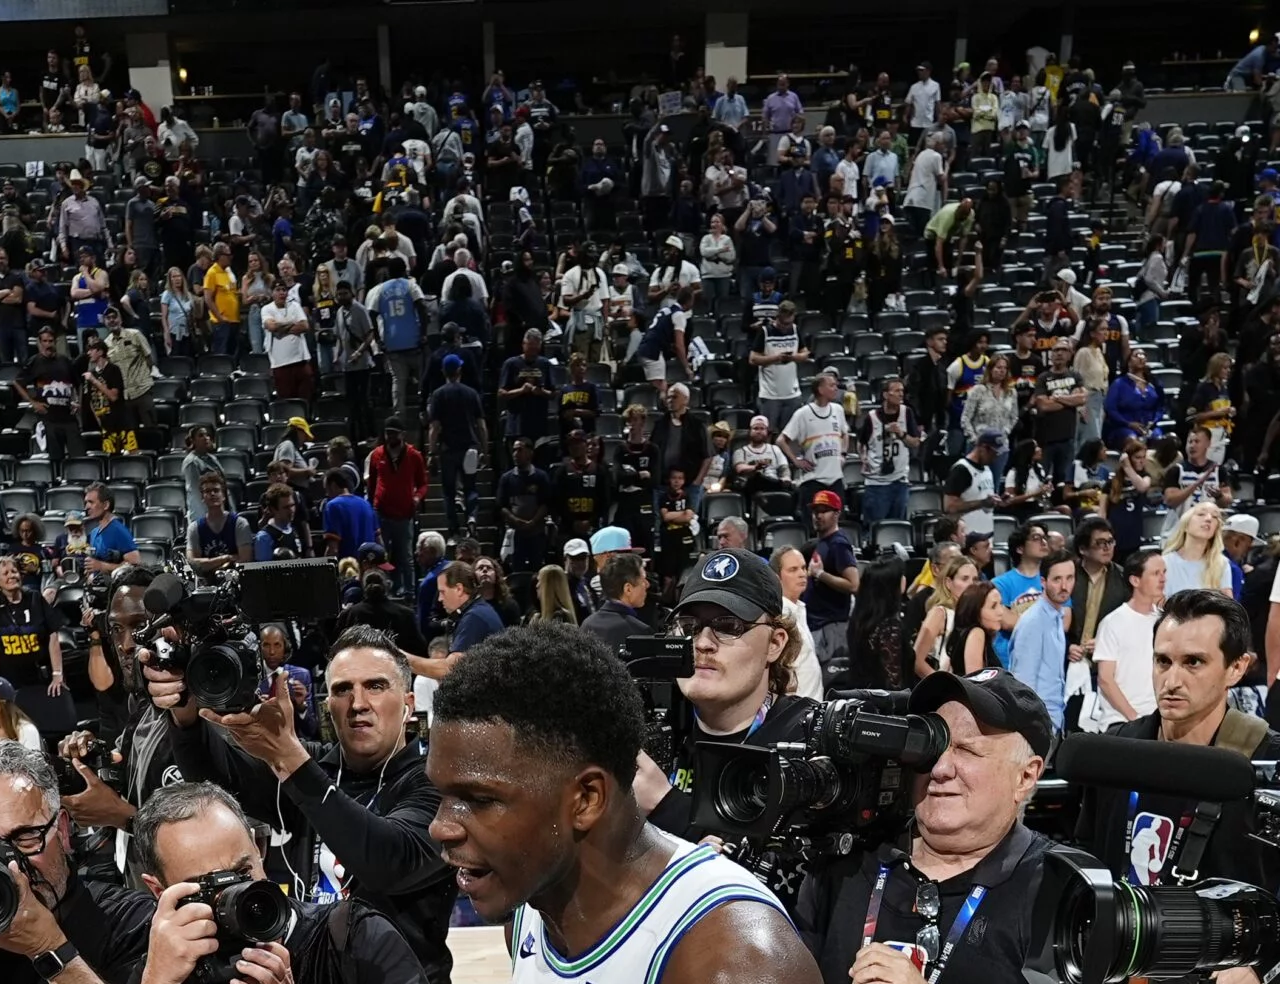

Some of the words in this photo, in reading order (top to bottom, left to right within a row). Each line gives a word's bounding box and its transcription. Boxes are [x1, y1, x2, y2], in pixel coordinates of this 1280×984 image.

[389, 300, 405, 317] 15
[861, 730, 881, 738] SONY
[1258, 795, 1277, 807] SONY
[217, 875, 235, 883] SONY
